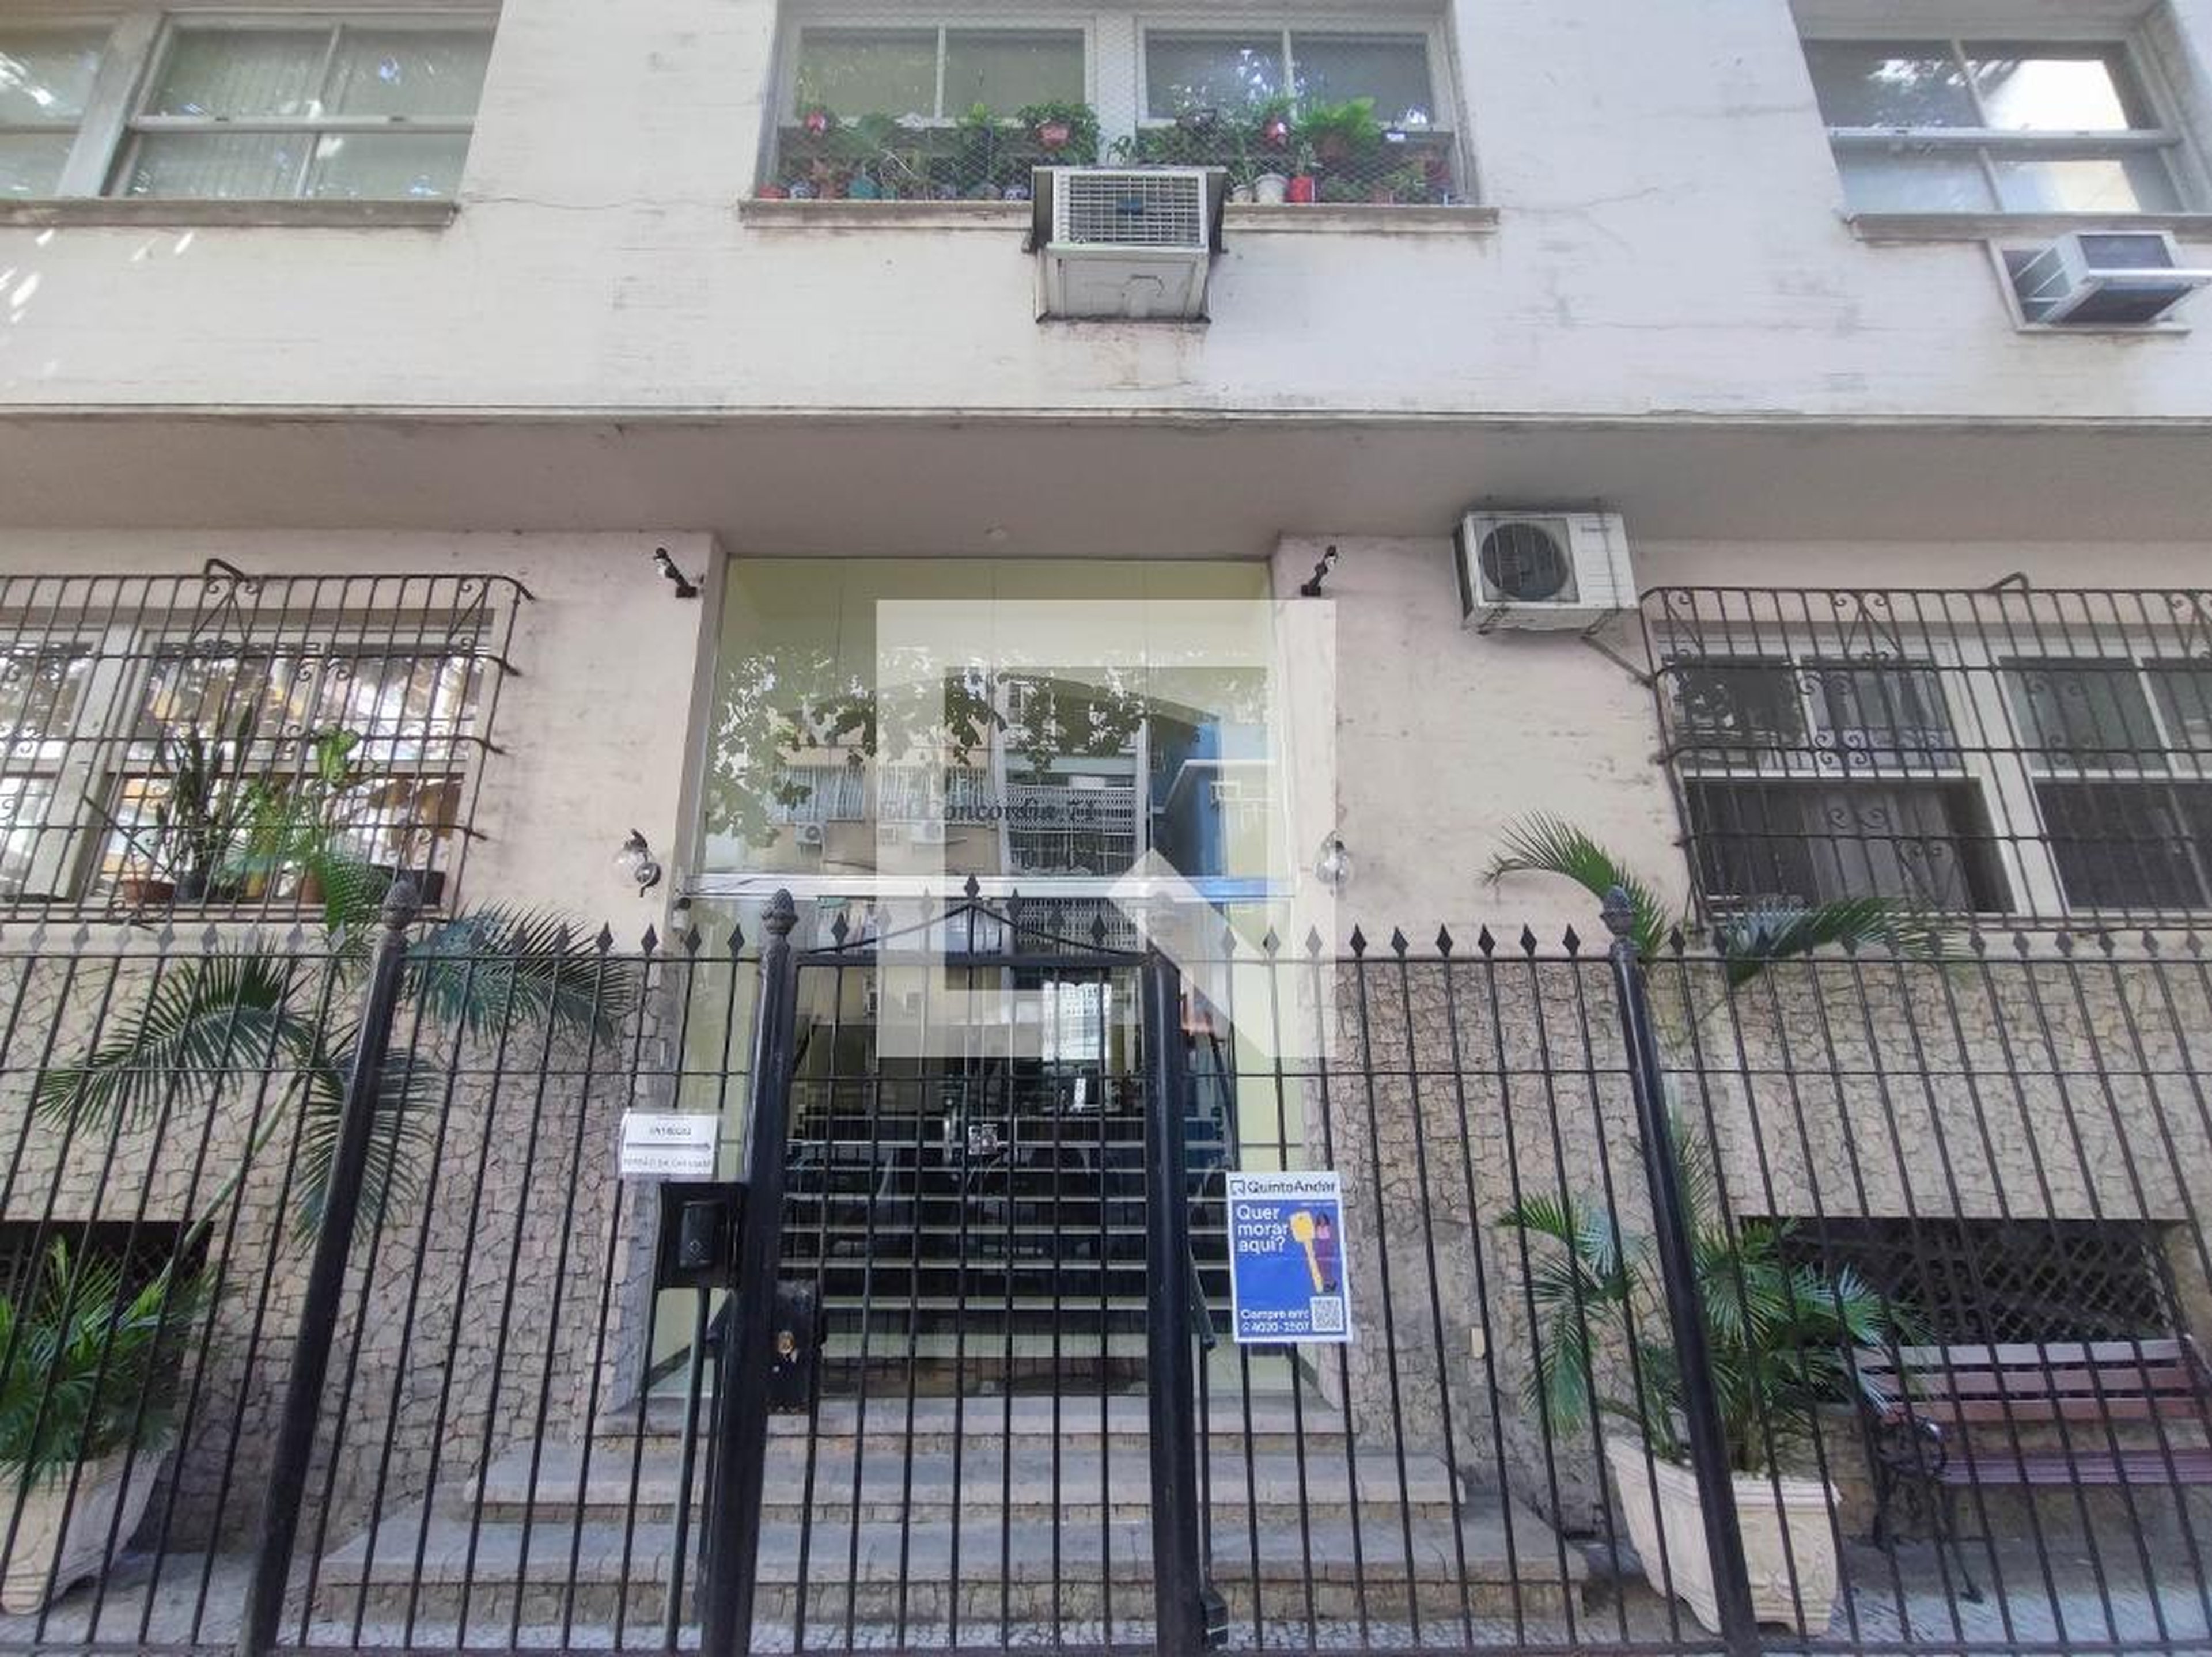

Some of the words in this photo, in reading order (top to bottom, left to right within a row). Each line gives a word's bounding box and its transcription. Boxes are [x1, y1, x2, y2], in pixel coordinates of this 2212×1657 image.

[1247, 1181, 1335, 1194] QuintoAndar
[1237, 1205, 1281, 1220] Quer
[1238, 1223, 1289, 1236] morar
[1238, 1235, 1286, 1254] aqui?
[1240, 1309, 1286, 1320] Compre
